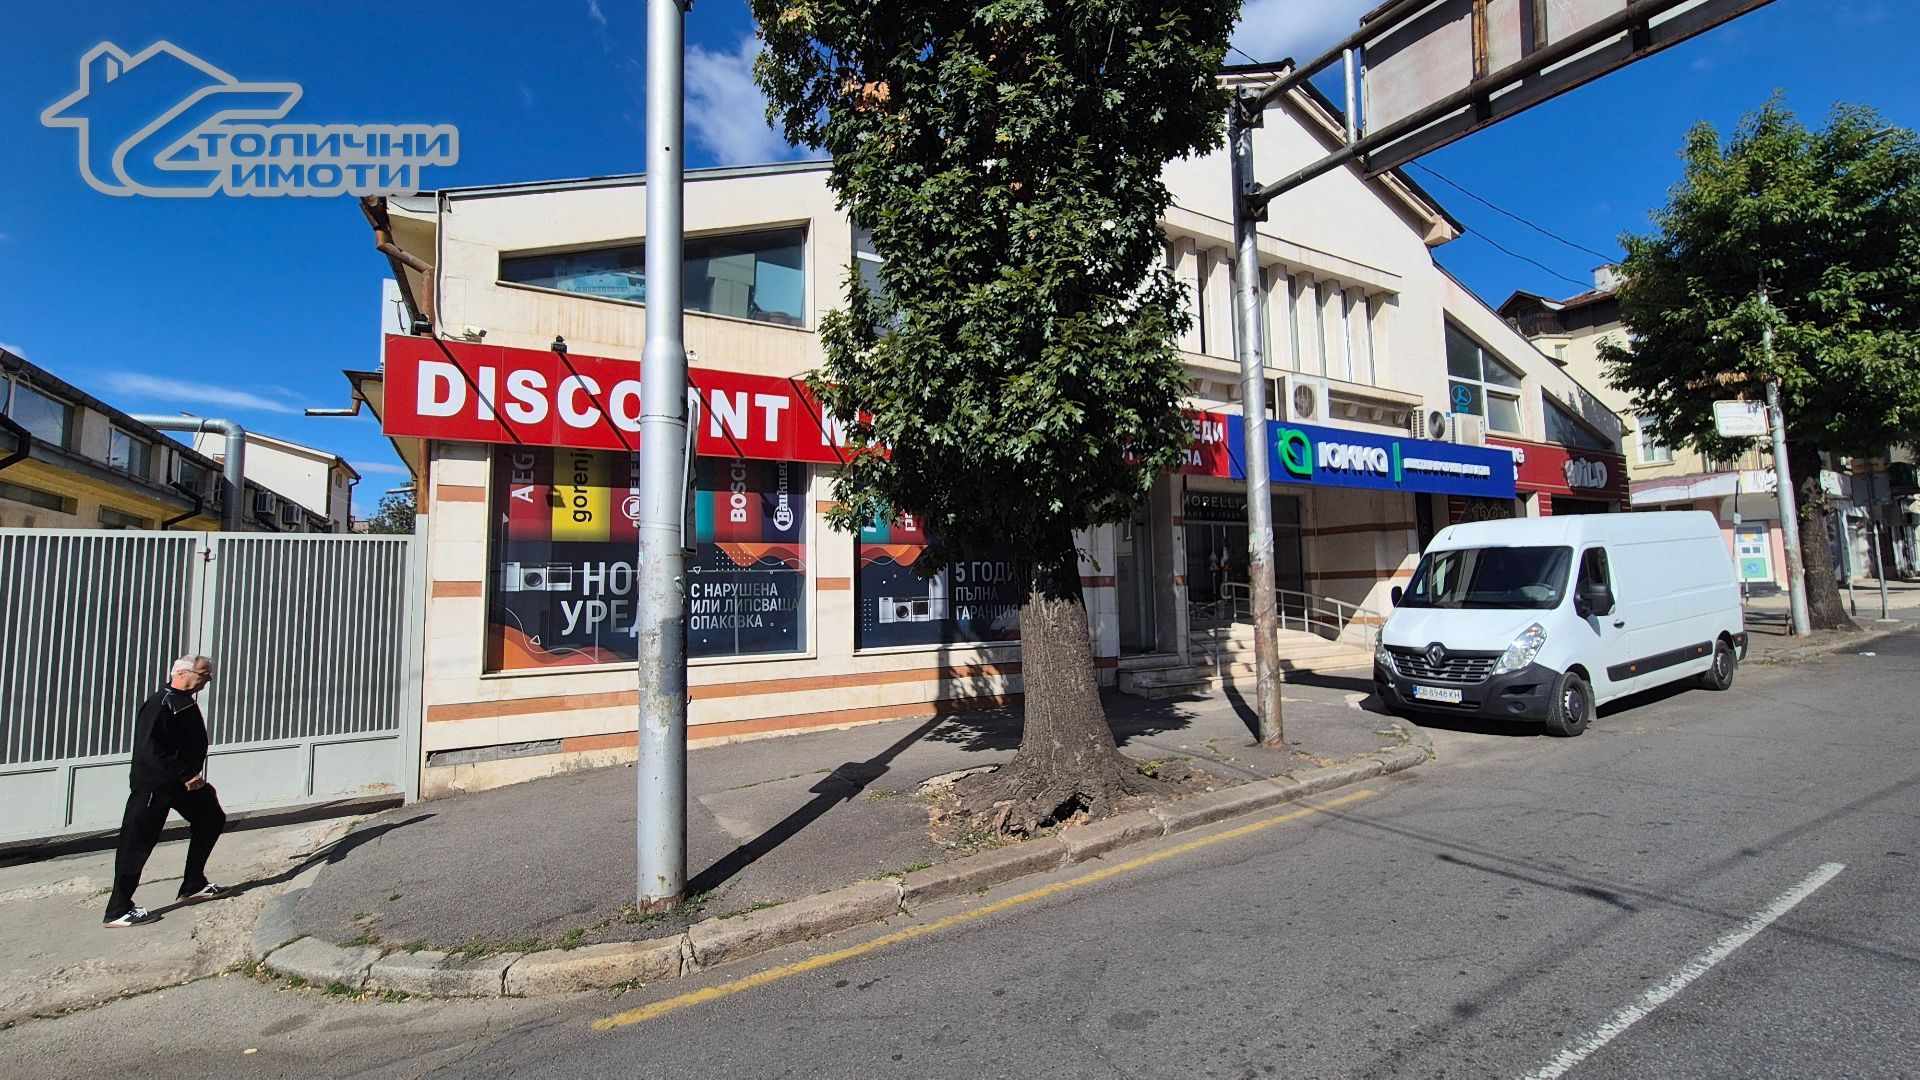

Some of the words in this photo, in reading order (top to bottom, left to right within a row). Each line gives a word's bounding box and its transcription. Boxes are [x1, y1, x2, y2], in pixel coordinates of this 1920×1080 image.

[511, 453, 535, 504] AEG
[570, 449, 593, 522] gorenj
[955, 561, 966, 583] 5
[690, 583, 700, 598] С
[704, 582, 779, 598] НАРУШЕНА
[955, 586, 999, 602] ПЪЛНА
[691, 599, 720, 614] ИЛИ
[723, 597, 799, 613] ЛИПСВАЩА
[955, 603, 1019, 621] ГАРАНЦИЯ
[690, 613, 763, 631] ОПАКОВКА
